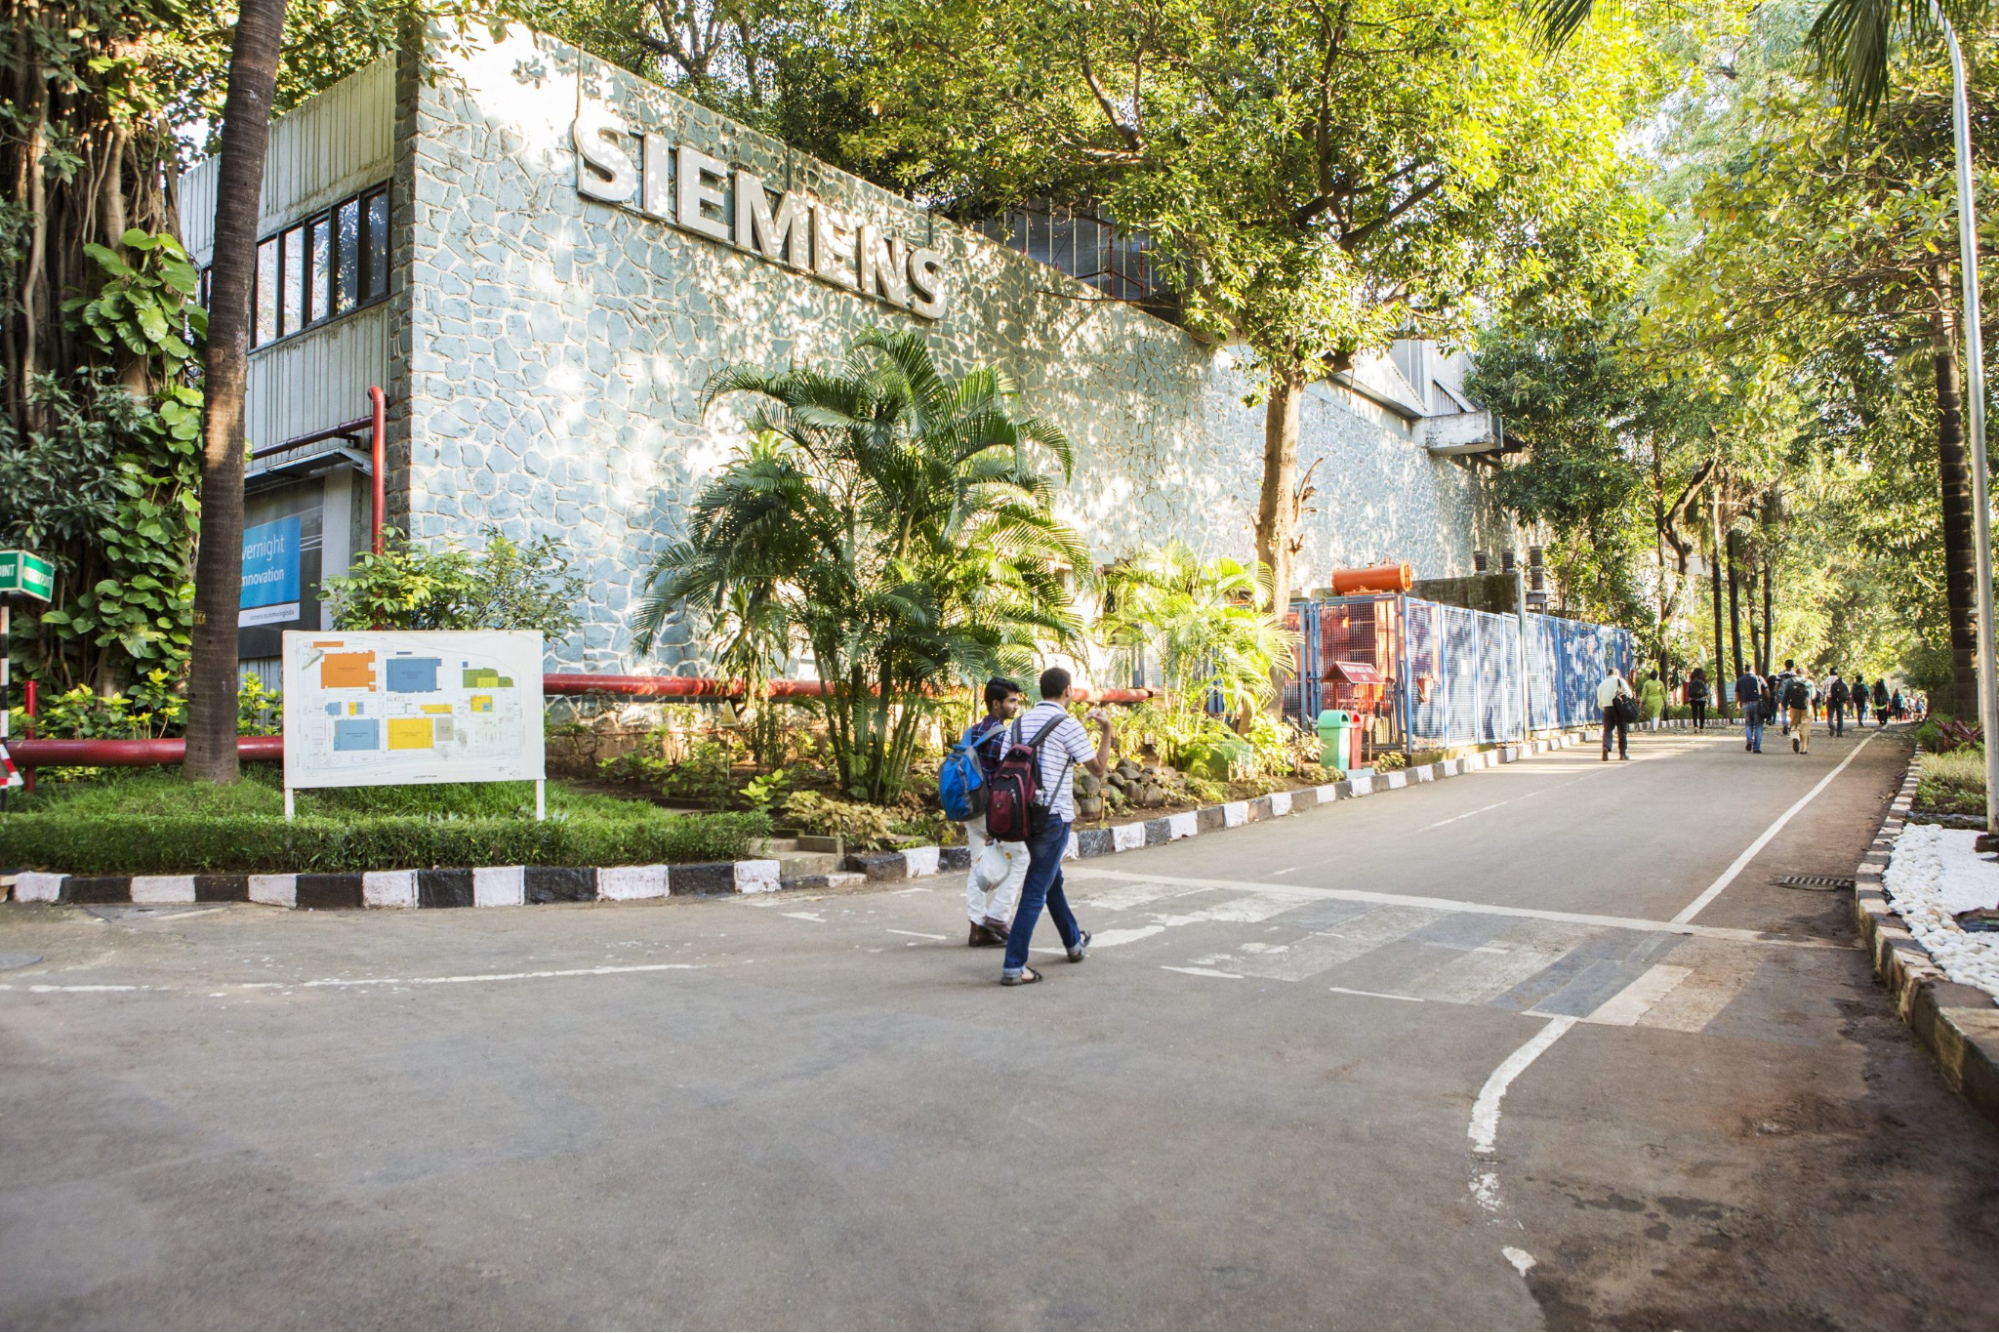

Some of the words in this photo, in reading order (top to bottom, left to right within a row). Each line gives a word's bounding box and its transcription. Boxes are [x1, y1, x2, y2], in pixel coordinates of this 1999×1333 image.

[573, 111, 948, 319] SIEMENS
[242, 534, 285, 561] vernight
[241, 566, 285, 587] nnovation
